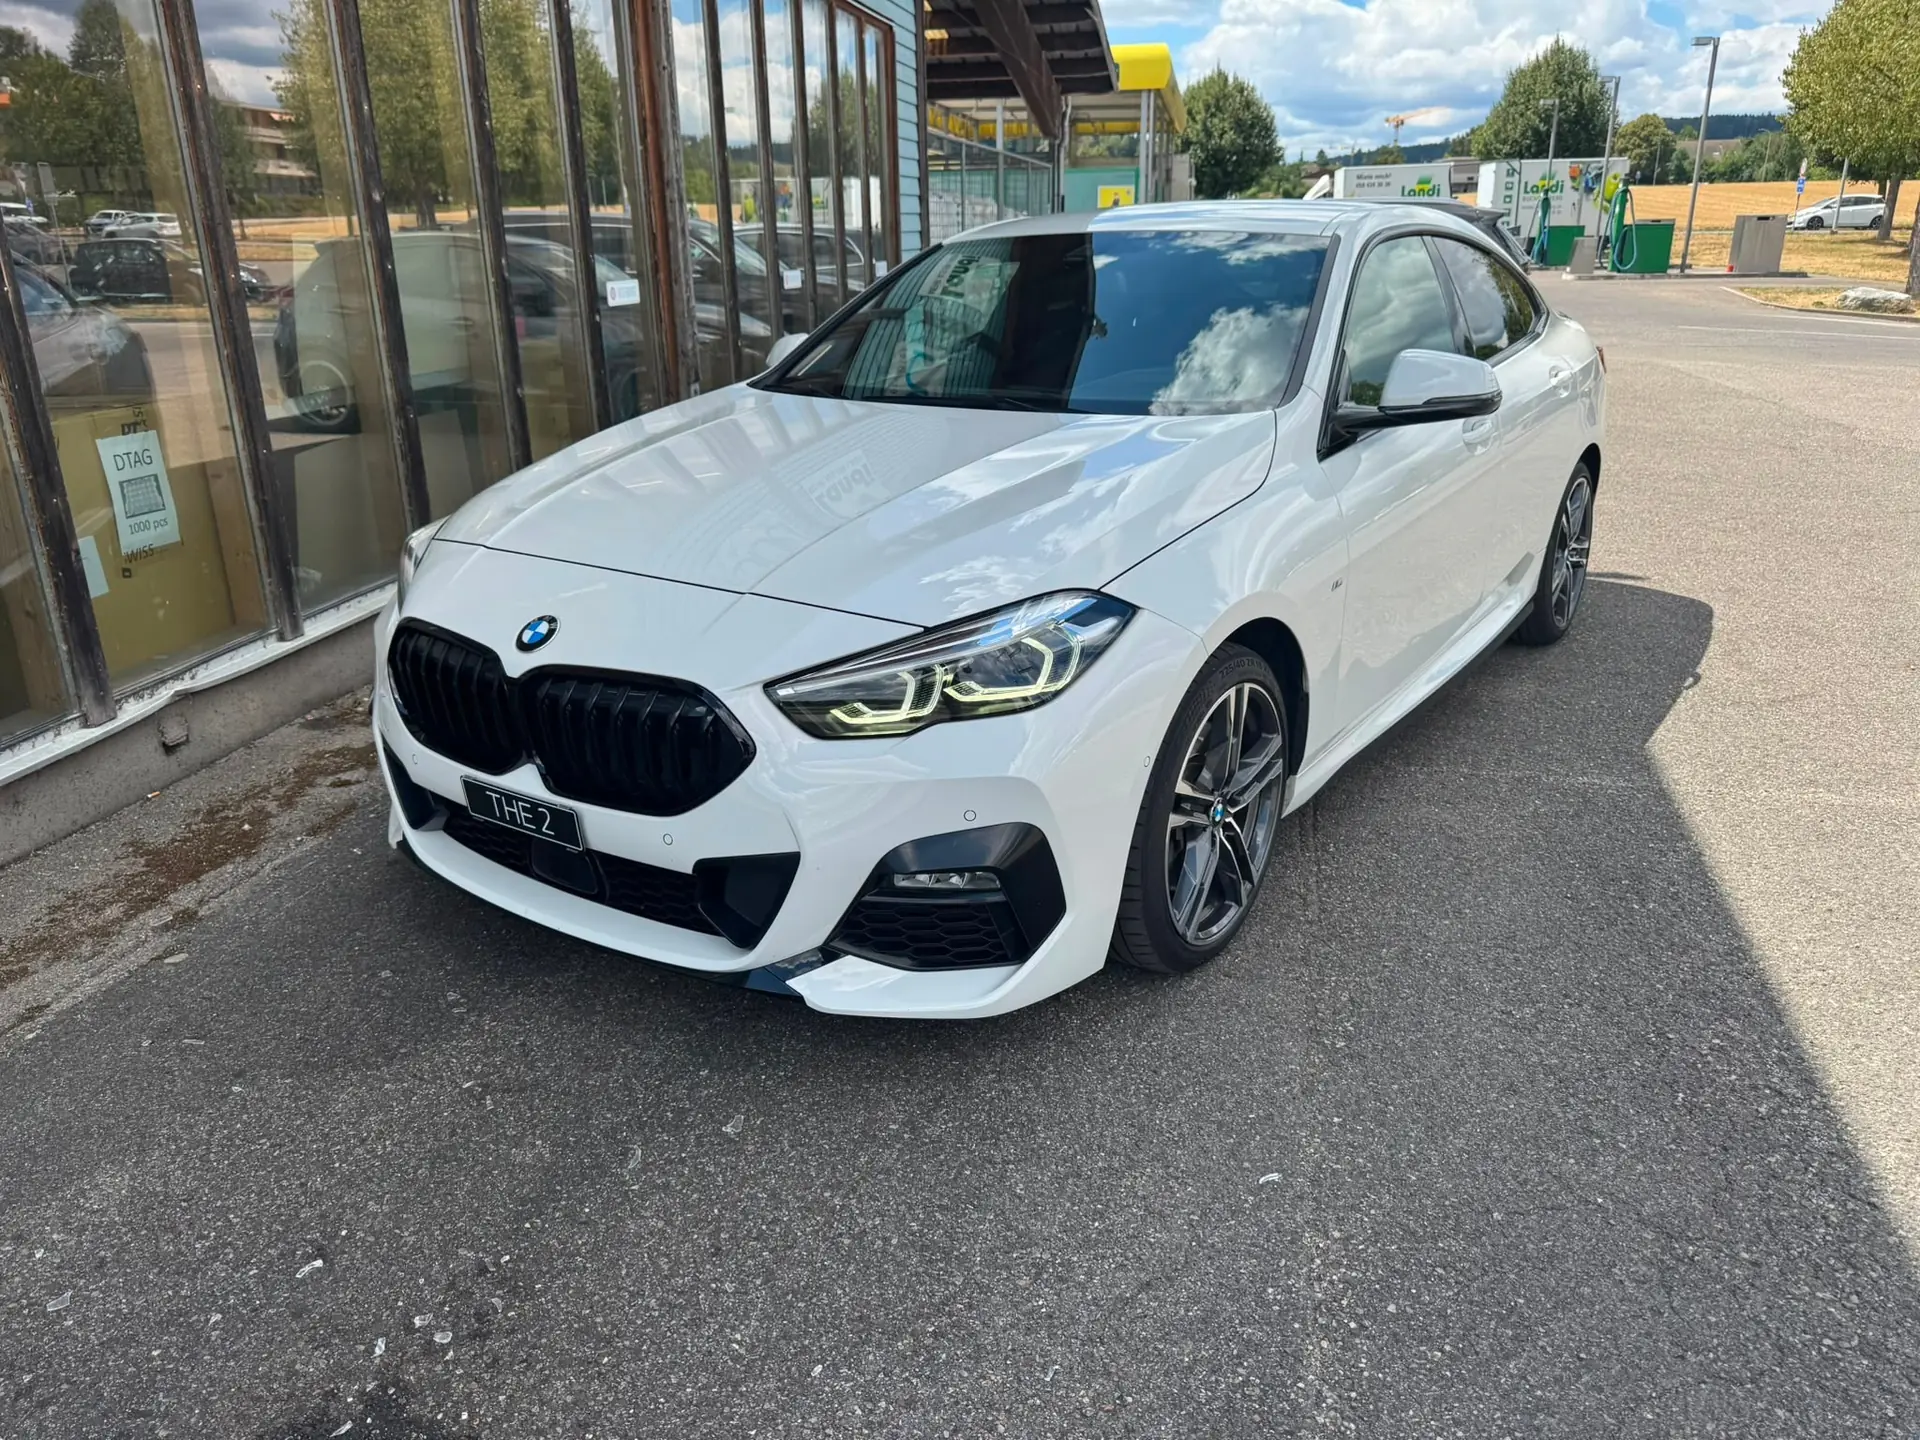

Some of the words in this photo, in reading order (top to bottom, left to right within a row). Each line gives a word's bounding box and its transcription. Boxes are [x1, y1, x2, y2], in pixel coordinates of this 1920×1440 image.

[1401, 184, 1440, 197] Landi
[113, 449, 153, 471] DTAG
[128, 520, 151, 534] 1000
[153, 517, 168, 531] pcs
[485, 791, 536, 829] THE
[537, 807, 555, 835] 2
